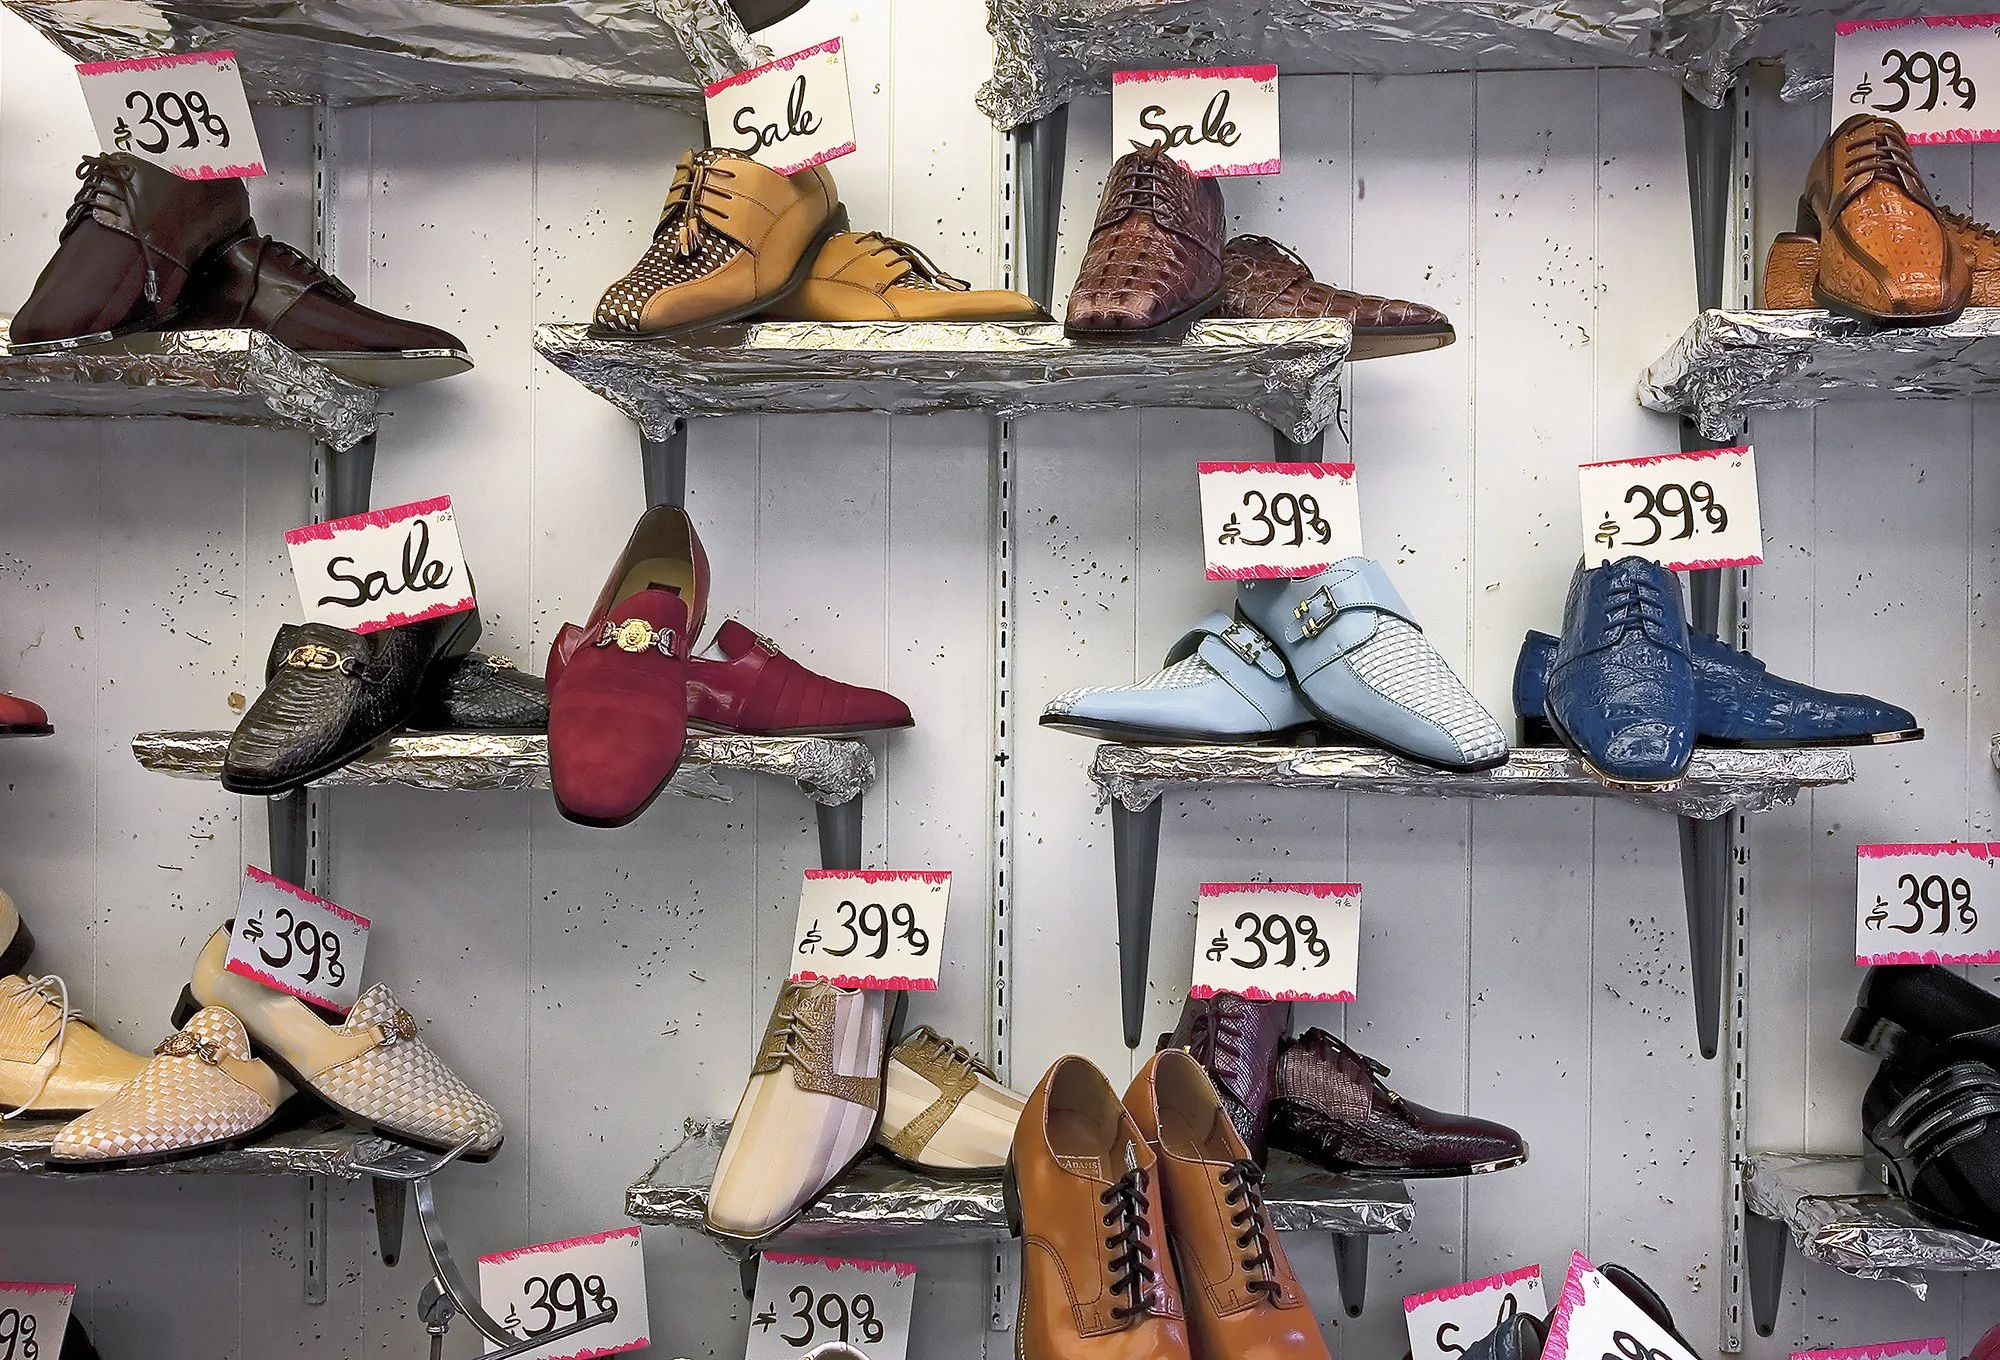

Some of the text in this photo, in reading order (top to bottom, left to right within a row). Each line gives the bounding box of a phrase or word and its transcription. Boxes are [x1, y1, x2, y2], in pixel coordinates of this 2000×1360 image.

[733, 75, 823, 156] Sale
[1139, 89, 1242, 152] Sale
[318, 519, 453, 608] Sale
